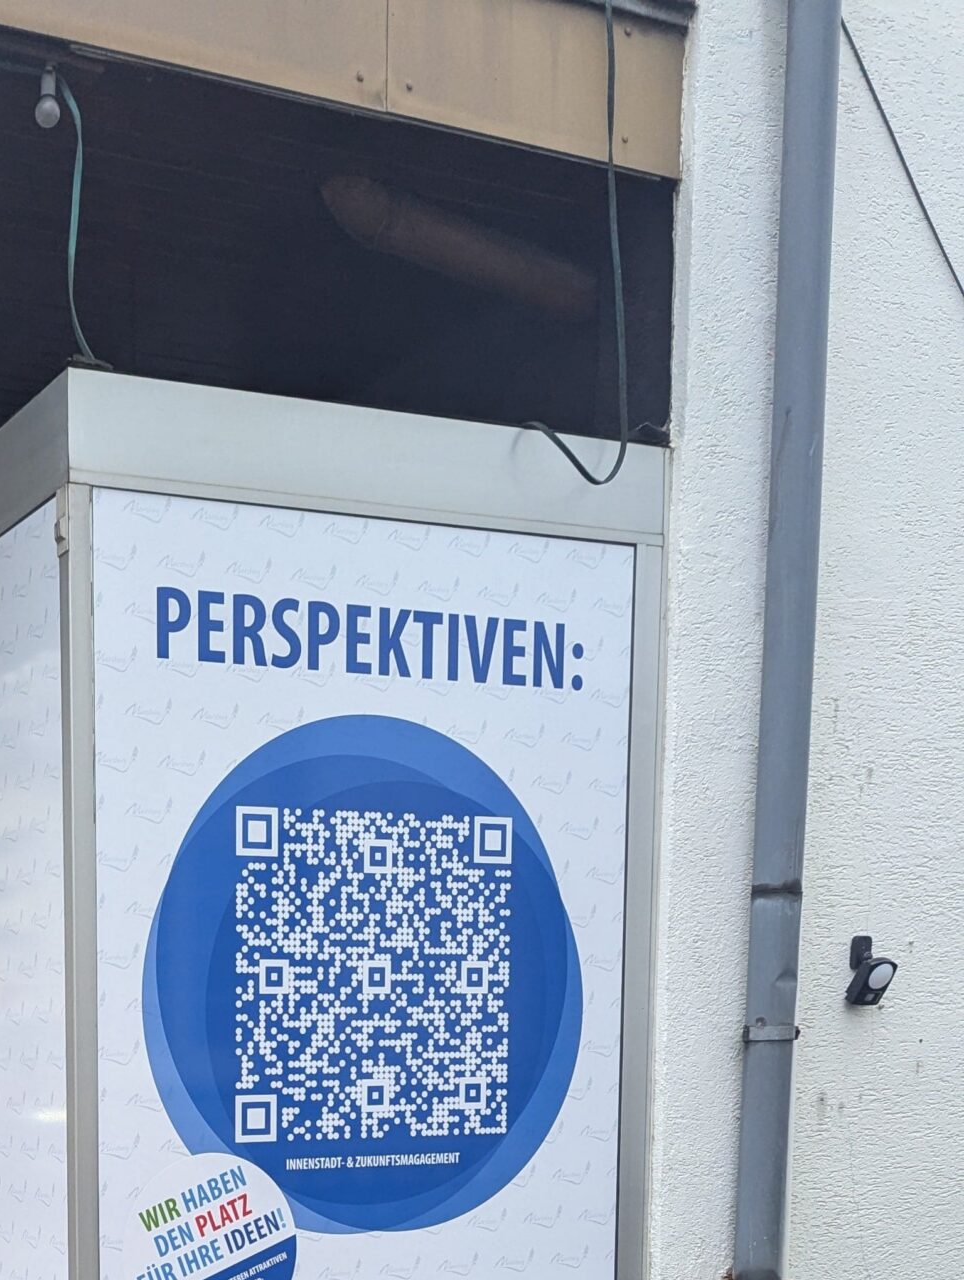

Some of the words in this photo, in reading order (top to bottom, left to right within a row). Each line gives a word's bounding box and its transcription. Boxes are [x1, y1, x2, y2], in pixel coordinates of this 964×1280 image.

[156, 586, 585, 691] PERSPEKTIVEN:
[286, 1157, 344, 1171] INNENSTADT-
[347, 1156, 354, 1168] &
[138, 1197, 182, 1232] WIR
[181, 1165, 247, 1213] HABEN
[153, 1222, 195, 1258] DEN
[195, 1193, 253, 1238] PLATZ
[177, 1238, 224, 1277] IHRE
[224, 1207, 286, 1254] IDEEN!
[249, 1252, 287, 1277] ATTRAKTIVEN
